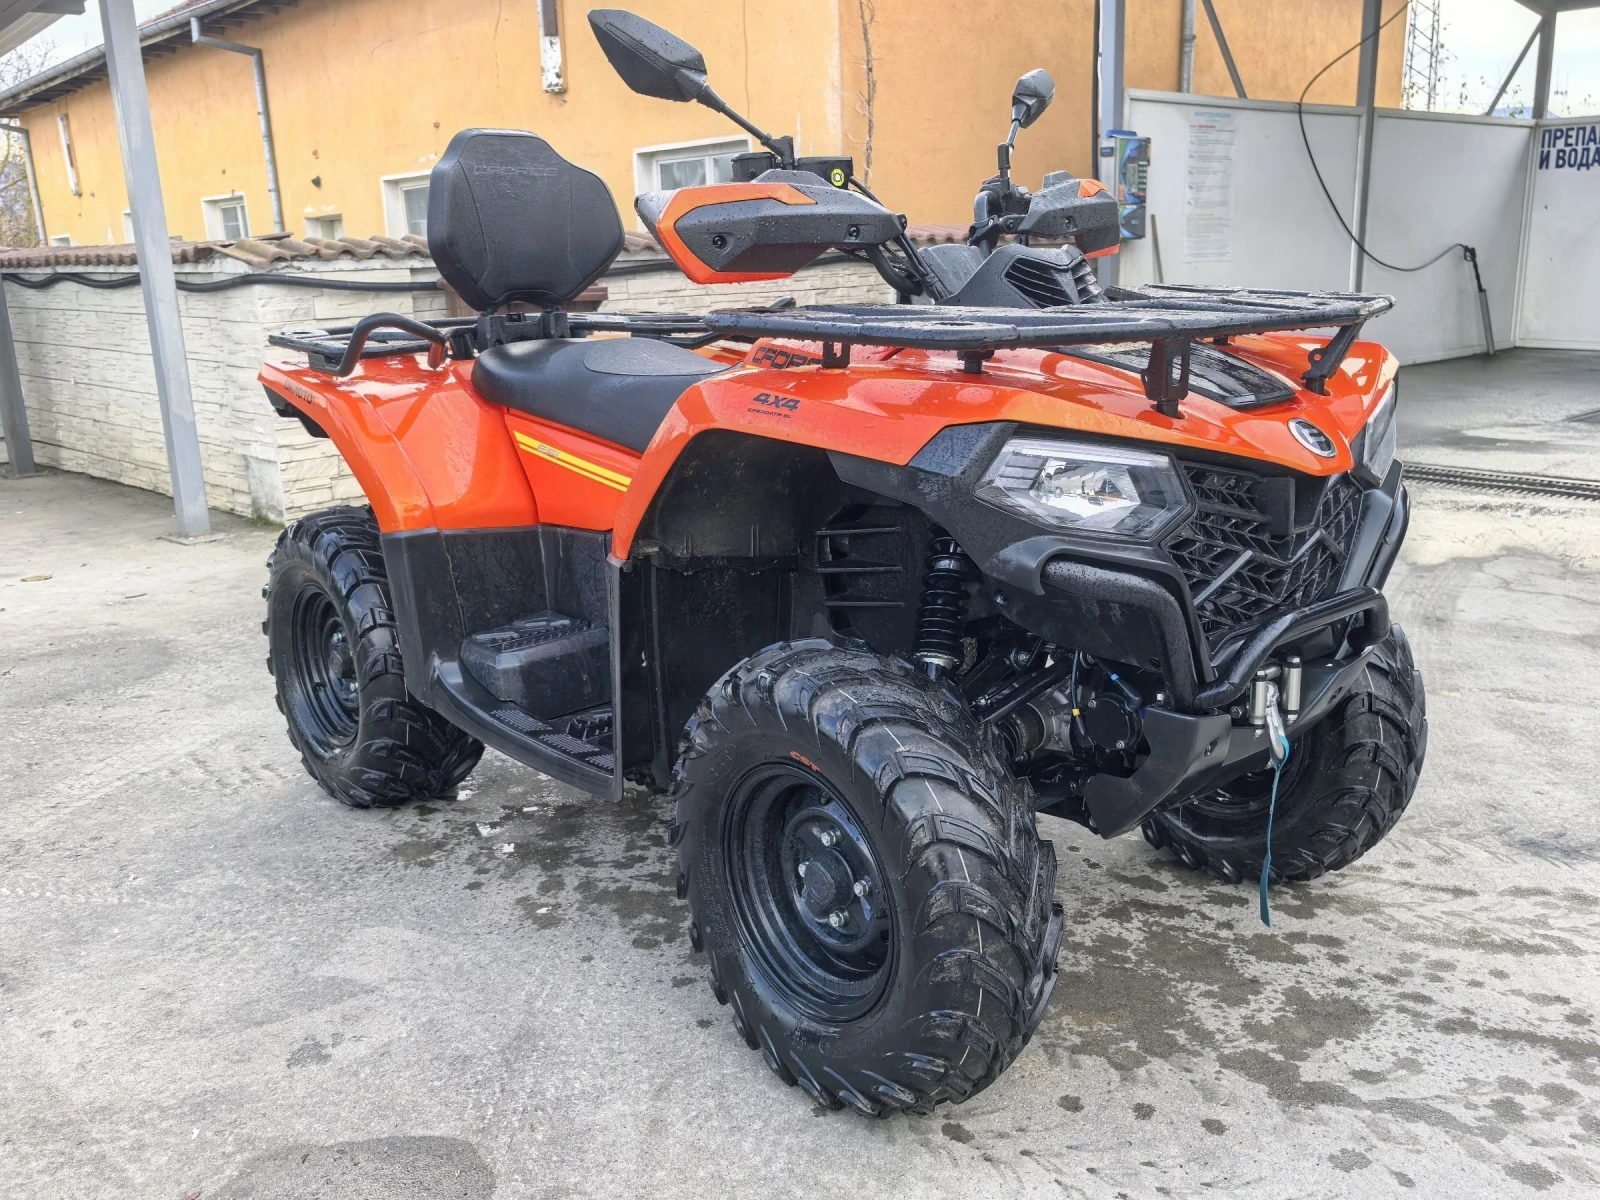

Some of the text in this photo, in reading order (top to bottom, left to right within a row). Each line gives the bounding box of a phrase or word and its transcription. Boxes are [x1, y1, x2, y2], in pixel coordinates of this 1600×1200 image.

[1542, 125, 1600, 148] ПРЕПА
[1539, 146, 1600, 171] И ВОДА
[789, 750, 820, 772] CST
